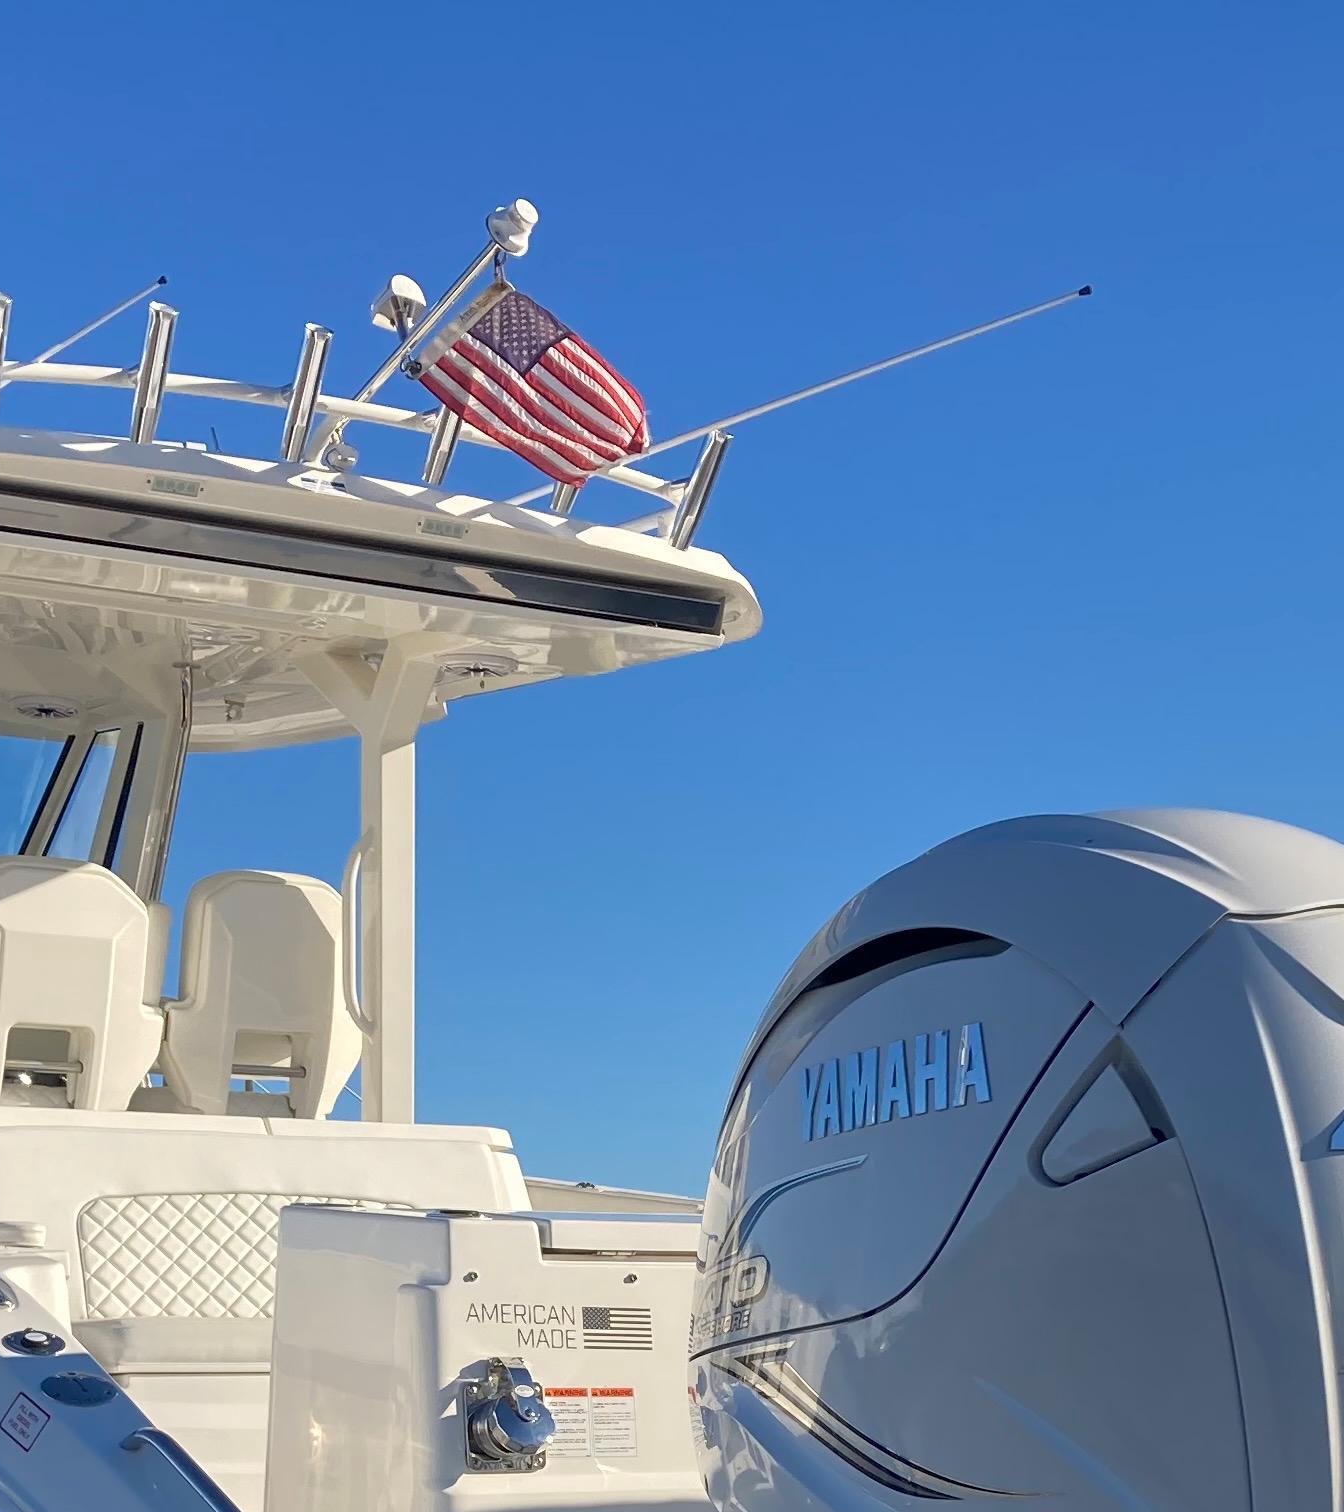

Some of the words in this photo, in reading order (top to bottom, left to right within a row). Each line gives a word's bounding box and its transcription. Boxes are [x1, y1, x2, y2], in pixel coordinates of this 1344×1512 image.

[798, 1022, 993, 1142] YAMAHA
[466, 1303, 576, 1325] AMERICAN
[517, 1328, 578, 1350] MADE
